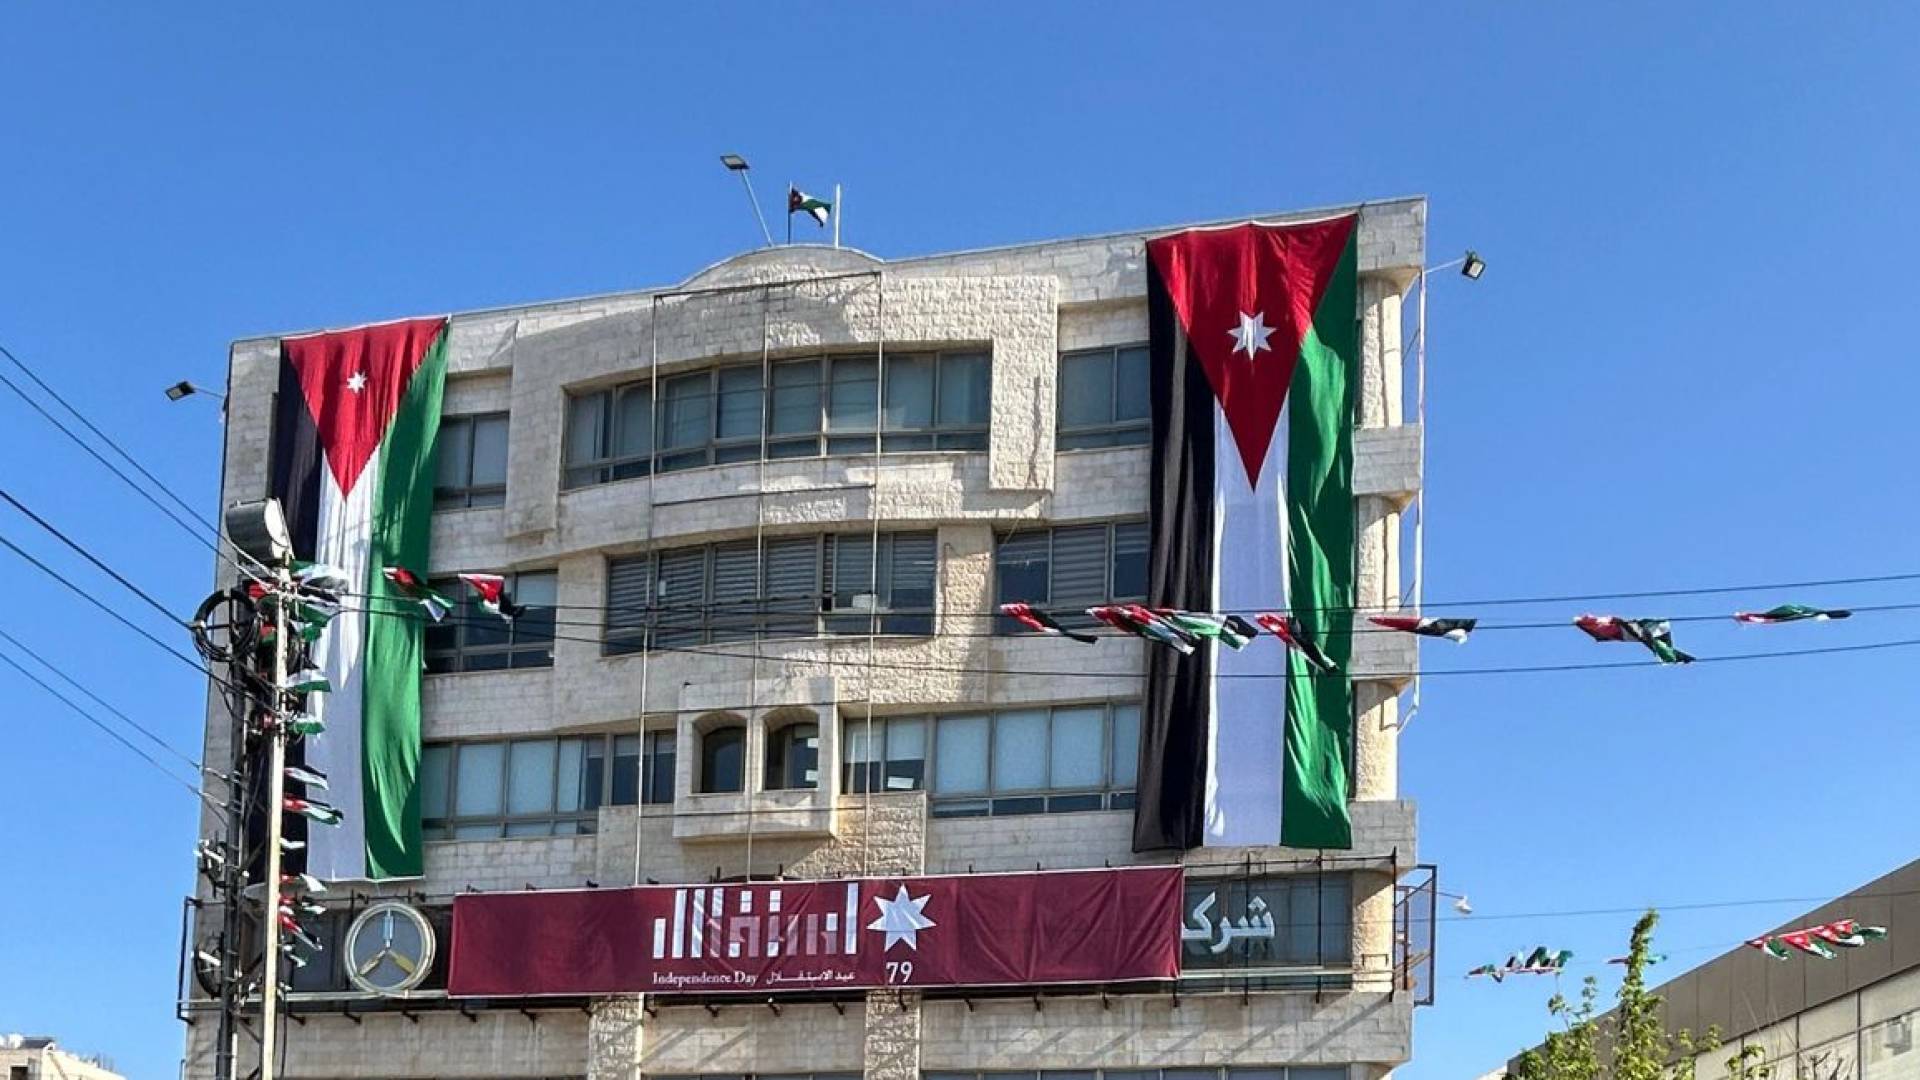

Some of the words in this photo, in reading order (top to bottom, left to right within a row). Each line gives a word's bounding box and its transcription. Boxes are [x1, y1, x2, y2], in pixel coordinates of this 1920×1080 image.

[1181, 891, 1275, 953] شرك
[653, 971, 731, 987] Independence
[734, 971, 758, 987] Day
[886, 961, 913, 983] 79
